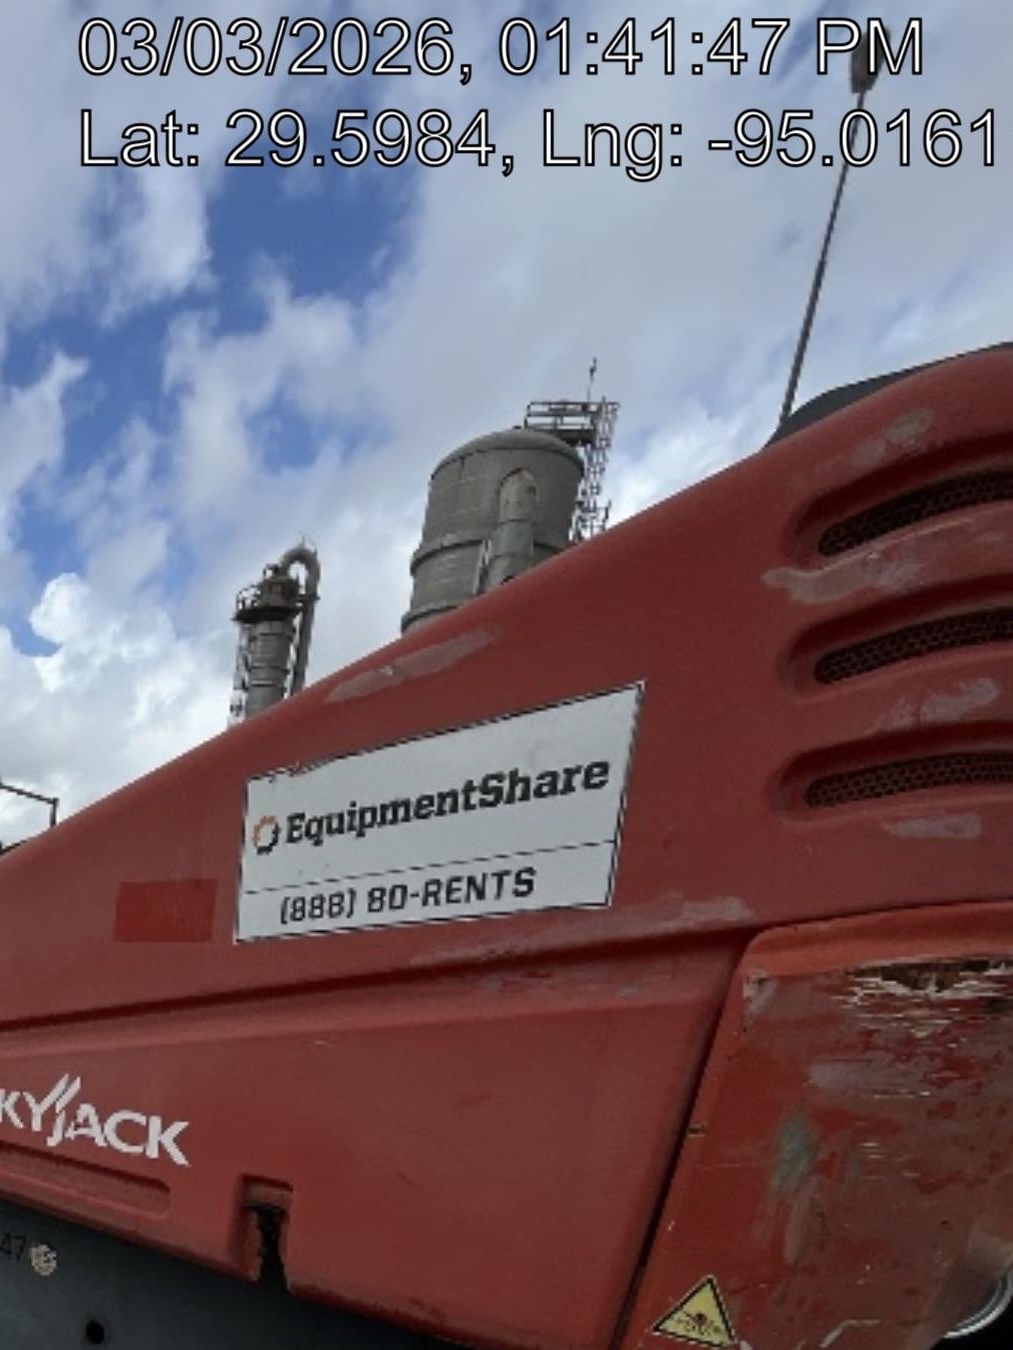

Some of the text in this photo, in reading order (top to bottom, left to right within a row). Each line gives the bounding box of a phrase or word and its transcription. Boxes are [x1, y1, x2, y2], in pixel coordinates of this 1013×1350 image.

[286, 760, 609, 846] EquipmentShare
[280, 866, 536, 926] (888) 80-RENTS
